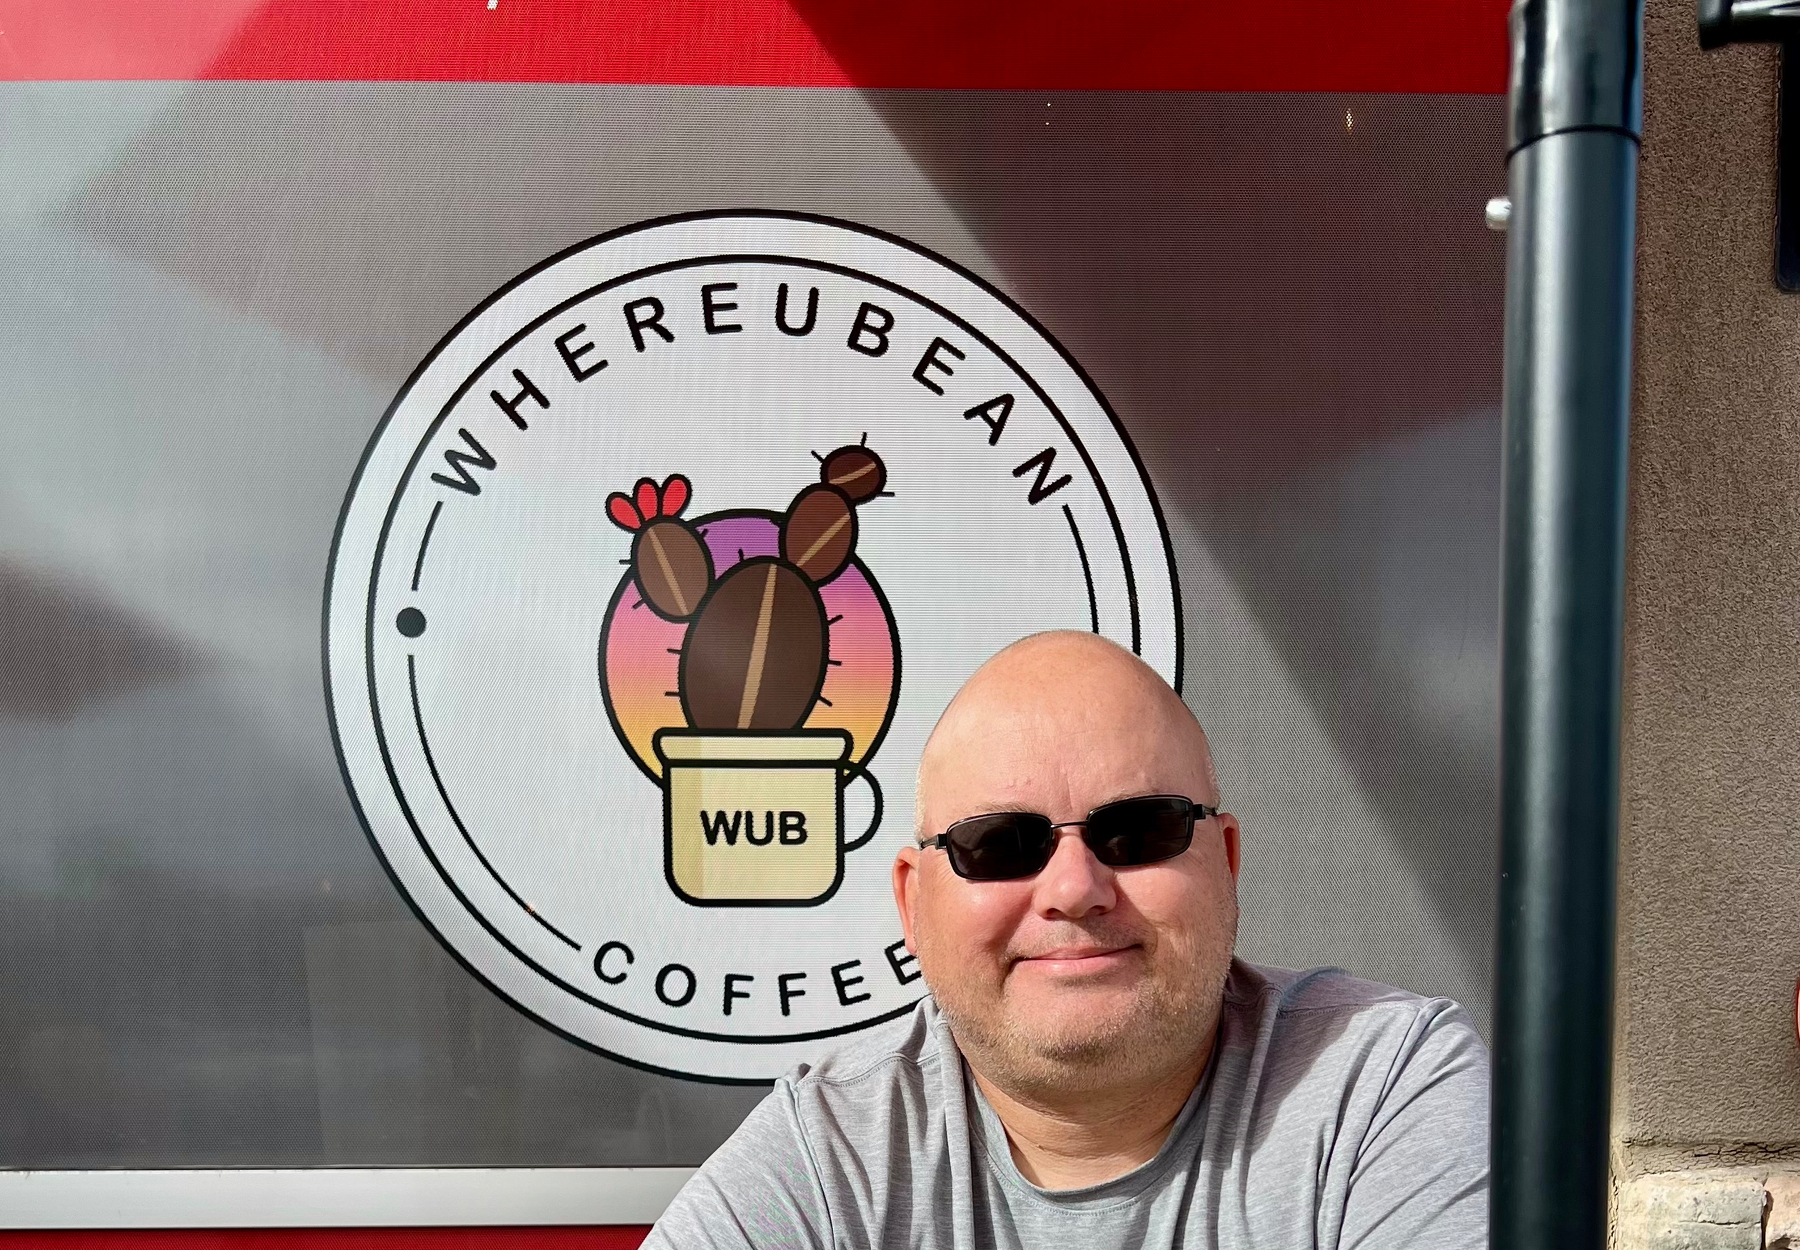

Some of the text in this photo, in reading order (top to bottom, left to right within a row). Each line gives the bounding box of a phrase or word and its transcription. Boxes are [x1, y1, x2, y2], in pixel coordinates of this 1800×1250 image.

[431, 282, 1073, 506] WHEREUBEAN
[700, 809, 808, 846] WUB
[593, 938, 922, 1017] COFFEE
